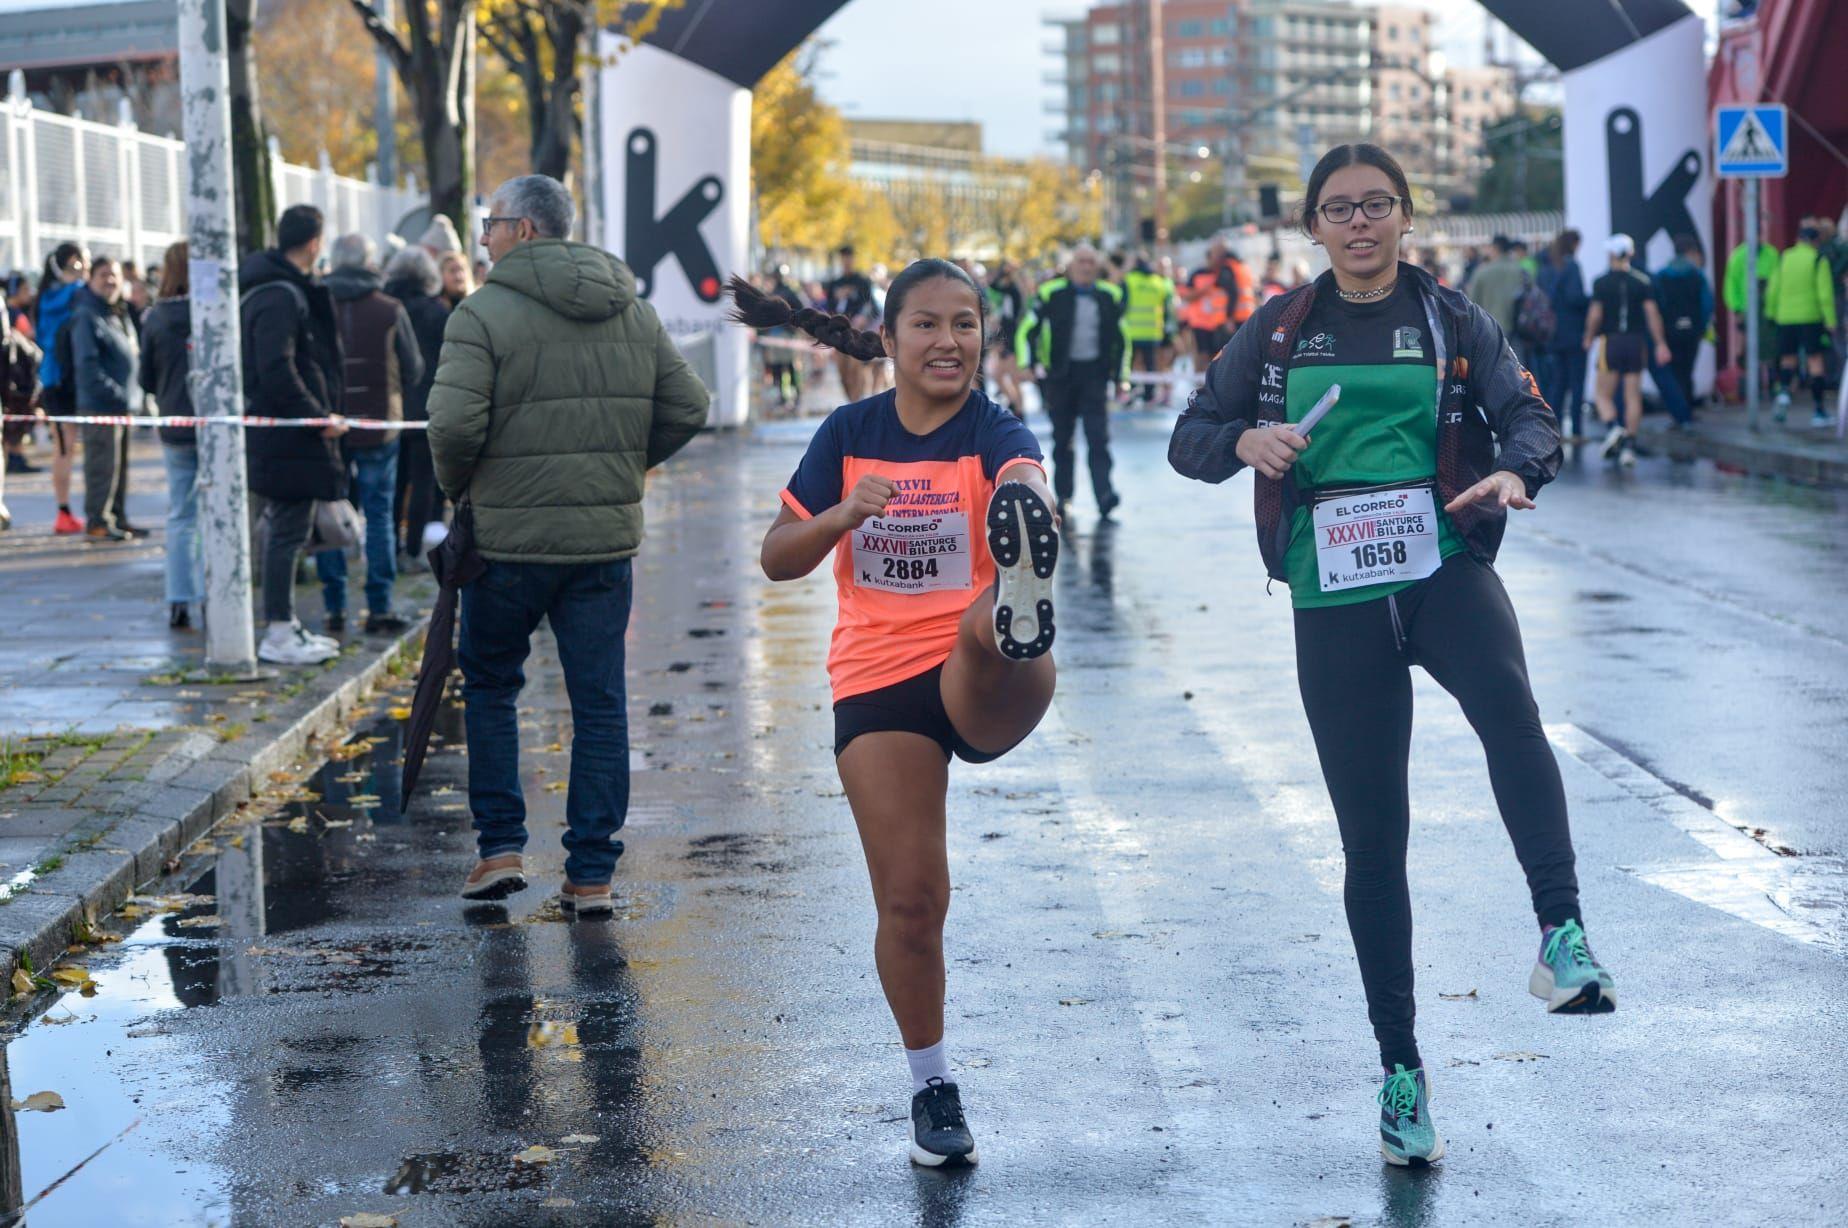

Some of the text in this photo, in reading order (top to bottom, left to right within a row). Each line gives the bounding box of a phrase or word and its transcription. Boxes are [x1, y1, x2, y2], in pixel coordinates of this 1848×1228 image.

[893, 479, 931, 490] XXVII
[1336, 507, 1351, 517] EL
[1352, 499, 1405, 514] CORREO
[872, 520, 938, 533] EL CORREO
[1376, 515, 1423, 528] SANTURCE
[1326, 520, 1376, 546] XXXVII
[1376, 523, 1425, 537] BILBAO
[862, 534, 907, 555] XXXVII
[909, 536, 957, 548] SANTURCE
[909, 543, 957, 556] BILBAO
[1351, 540, 1407, 570] 1658
[882, 557, 939, 580] 2884
[1343, 568, 1396, 582] kutxabank
[874, 577, 924, 589] kutxabank
